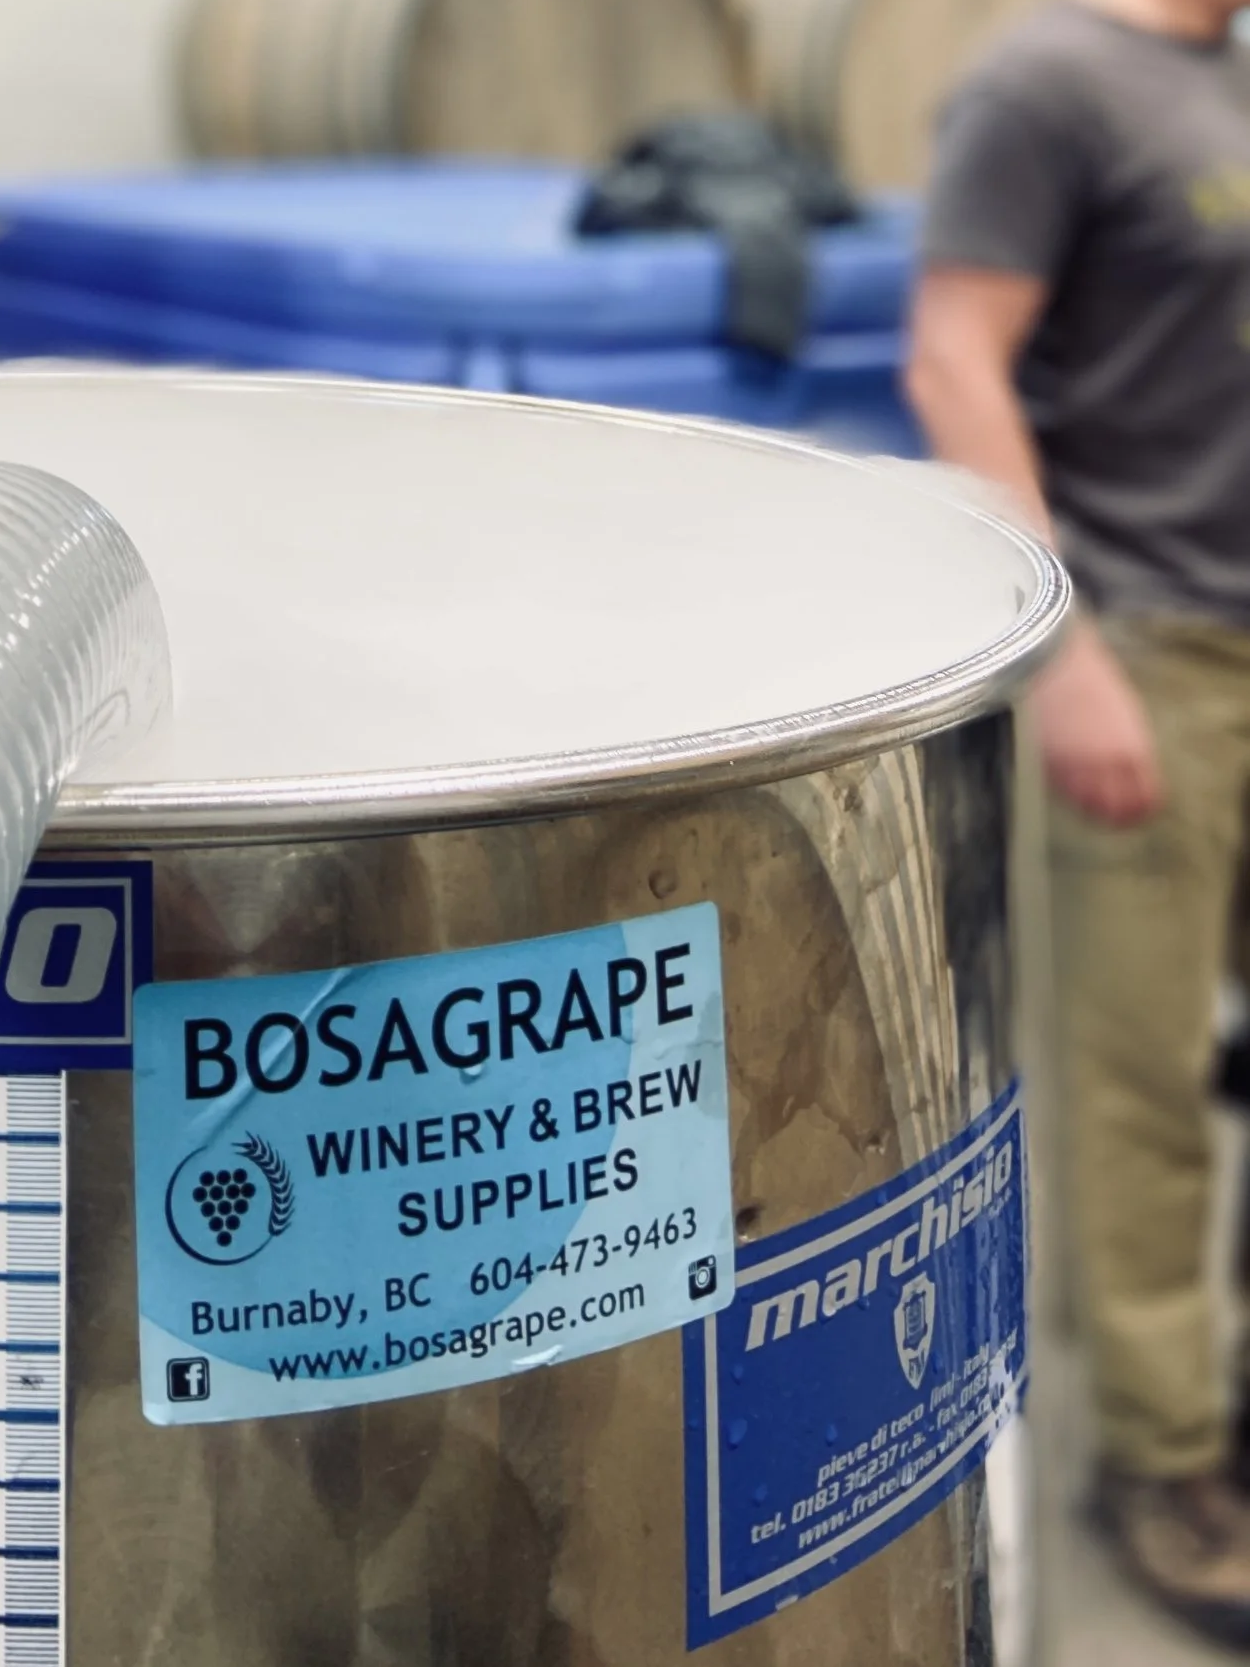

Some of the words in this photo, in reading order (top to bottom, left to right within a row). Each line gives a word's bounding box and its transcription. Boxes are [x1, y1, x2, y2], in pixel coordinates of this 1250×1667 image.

[184, 942, 693, 1100] BOSAGRAPE
[307, 1105, 514, 1177] WINERY
[529, 1099, 560, 1141] &
[573, 1060, 701, 1132] BREW
[398, 1147, 638, 1236] SUPPLIES
[192, 1288, 368, 1336] Burnaby,
[385, 1272, 431, 1312] BC
[470, 1206, 698, 1296] 604-473-9463
[745, 1141, 1012, 1352] marchisio
[268, 1281, 646, 1382] www.bosagrape.com
[817, 1440, 868, 1488] pieve
[871, 1423, 888, 1452] di
[891, 1403, 925, 1438] teco
[751, 1512, 786, 1544] tel.
[791, 1482, 839, 1524] 0183
